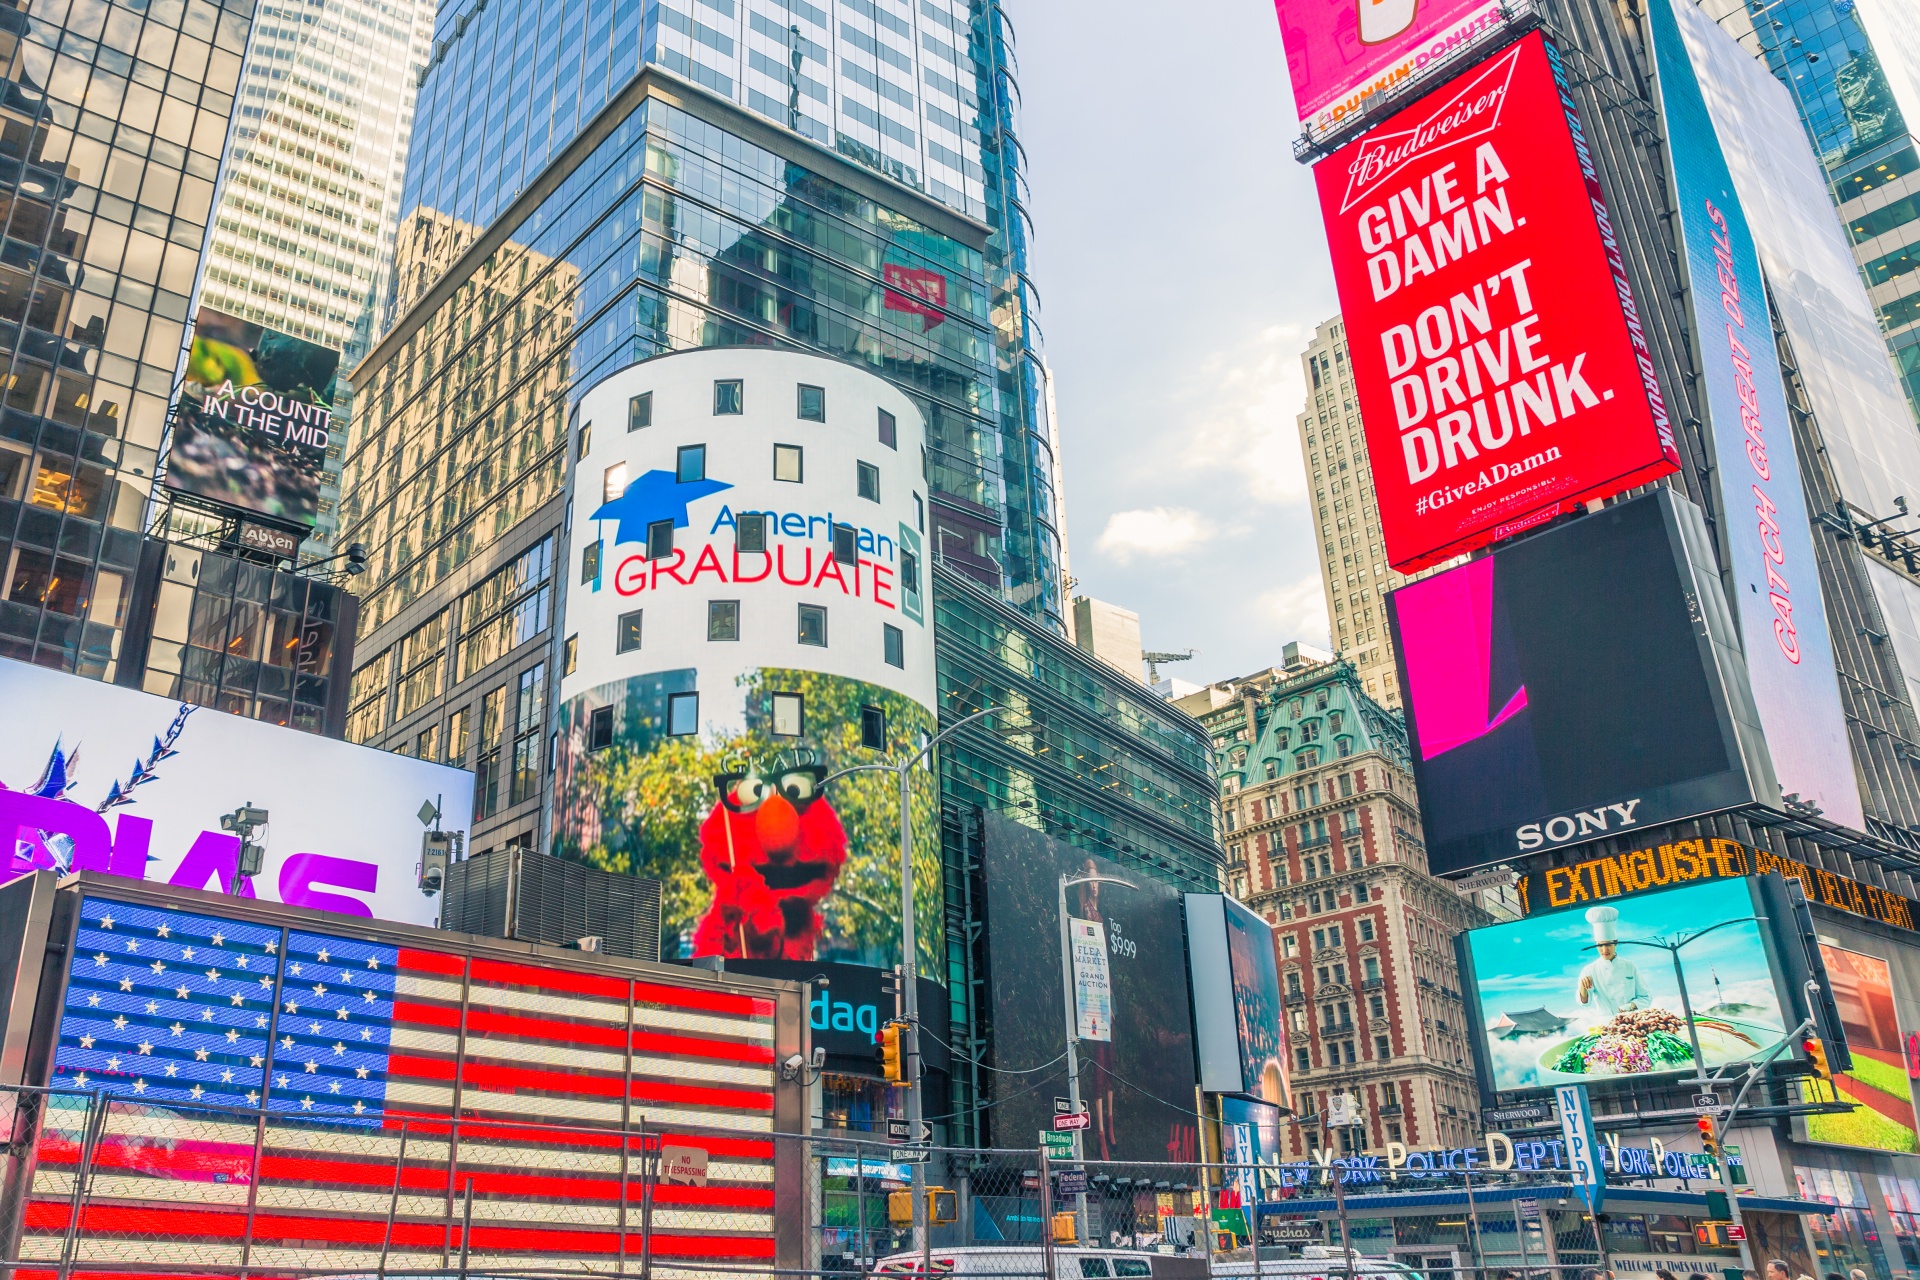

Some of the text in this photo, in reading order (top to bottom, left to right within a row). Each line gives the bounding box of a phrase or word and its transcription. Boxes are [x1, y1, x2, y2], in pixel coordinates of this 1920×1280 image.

[1415, 6, 1502, 70] DONUTS
[1347, 85, 1507, 187] Budweiser
[1358, 141, 1510, 254] GIVE A
[1366, 186, 1527, 303] DAMN.
[1544, 40, 1677, 454] GIVE A DAMN. DON'T DRIVE DRUNK.
[1380, 258, 1534, 380] DON'T
[1390, 313, 1551, 431] DRIVE
[217, 379, 236, 400] A
[203, 395, 329, 449] IN THE MID
[1400, 352, 1615, 486] DRUNK.
[1705, 198, 1801, 665] CATCH GREAT DEALS
[1415, 446, 1562, 516] #GiveADamn
[1471, 476, 1557, 515] ENJOY RESPONSIBLY
[246, 528, 293, 550] Absen
[1516, 799, 1641, 850] SONY
[1457, 873, 1511, 892] SHERWOOD
[1545, 838, 1750, 907] EXTINGUISHED
[1815, 868, 1869, 917] DELTA
[1865, 884, 1915, 931] FLIGHT
[1108, 917, 1122, 935] Top
[1077, 946, 1103, 957] FLEA
[1110, 933, 1137, 959] $9.99
[1075, 955, 1107, 966] MARKET
[1078, 980, 1108, 989] AUCTION
[1080, 972, 1105, 980] GRAND
[1493, 1108, 1541, 1121] SHERWOOD
[893, 1125, 907, 1134] ONE
[1046, 1133, 1072, 1145] Broadway
[1562, 1089, 1590, 1182] NYPD
[681, 1156, 691, 1164] NO
[895, 1150, 908, 1158] ONE
[1049, 1148, 1056, 1157] W
[1057, 1148, 1066, 1156] 43
[1238, 1126, 1253, 1203] NYPD
[1485, 1132, 1563, 1171] DEPT
[1692, 1156, 1709, 1165] W 43
[1060, 1173, 1085, 1182] Federal
[1614, 1259, 1655, 1272] WELCOME
[1665, 1261, 1690, 1273] TIMES
